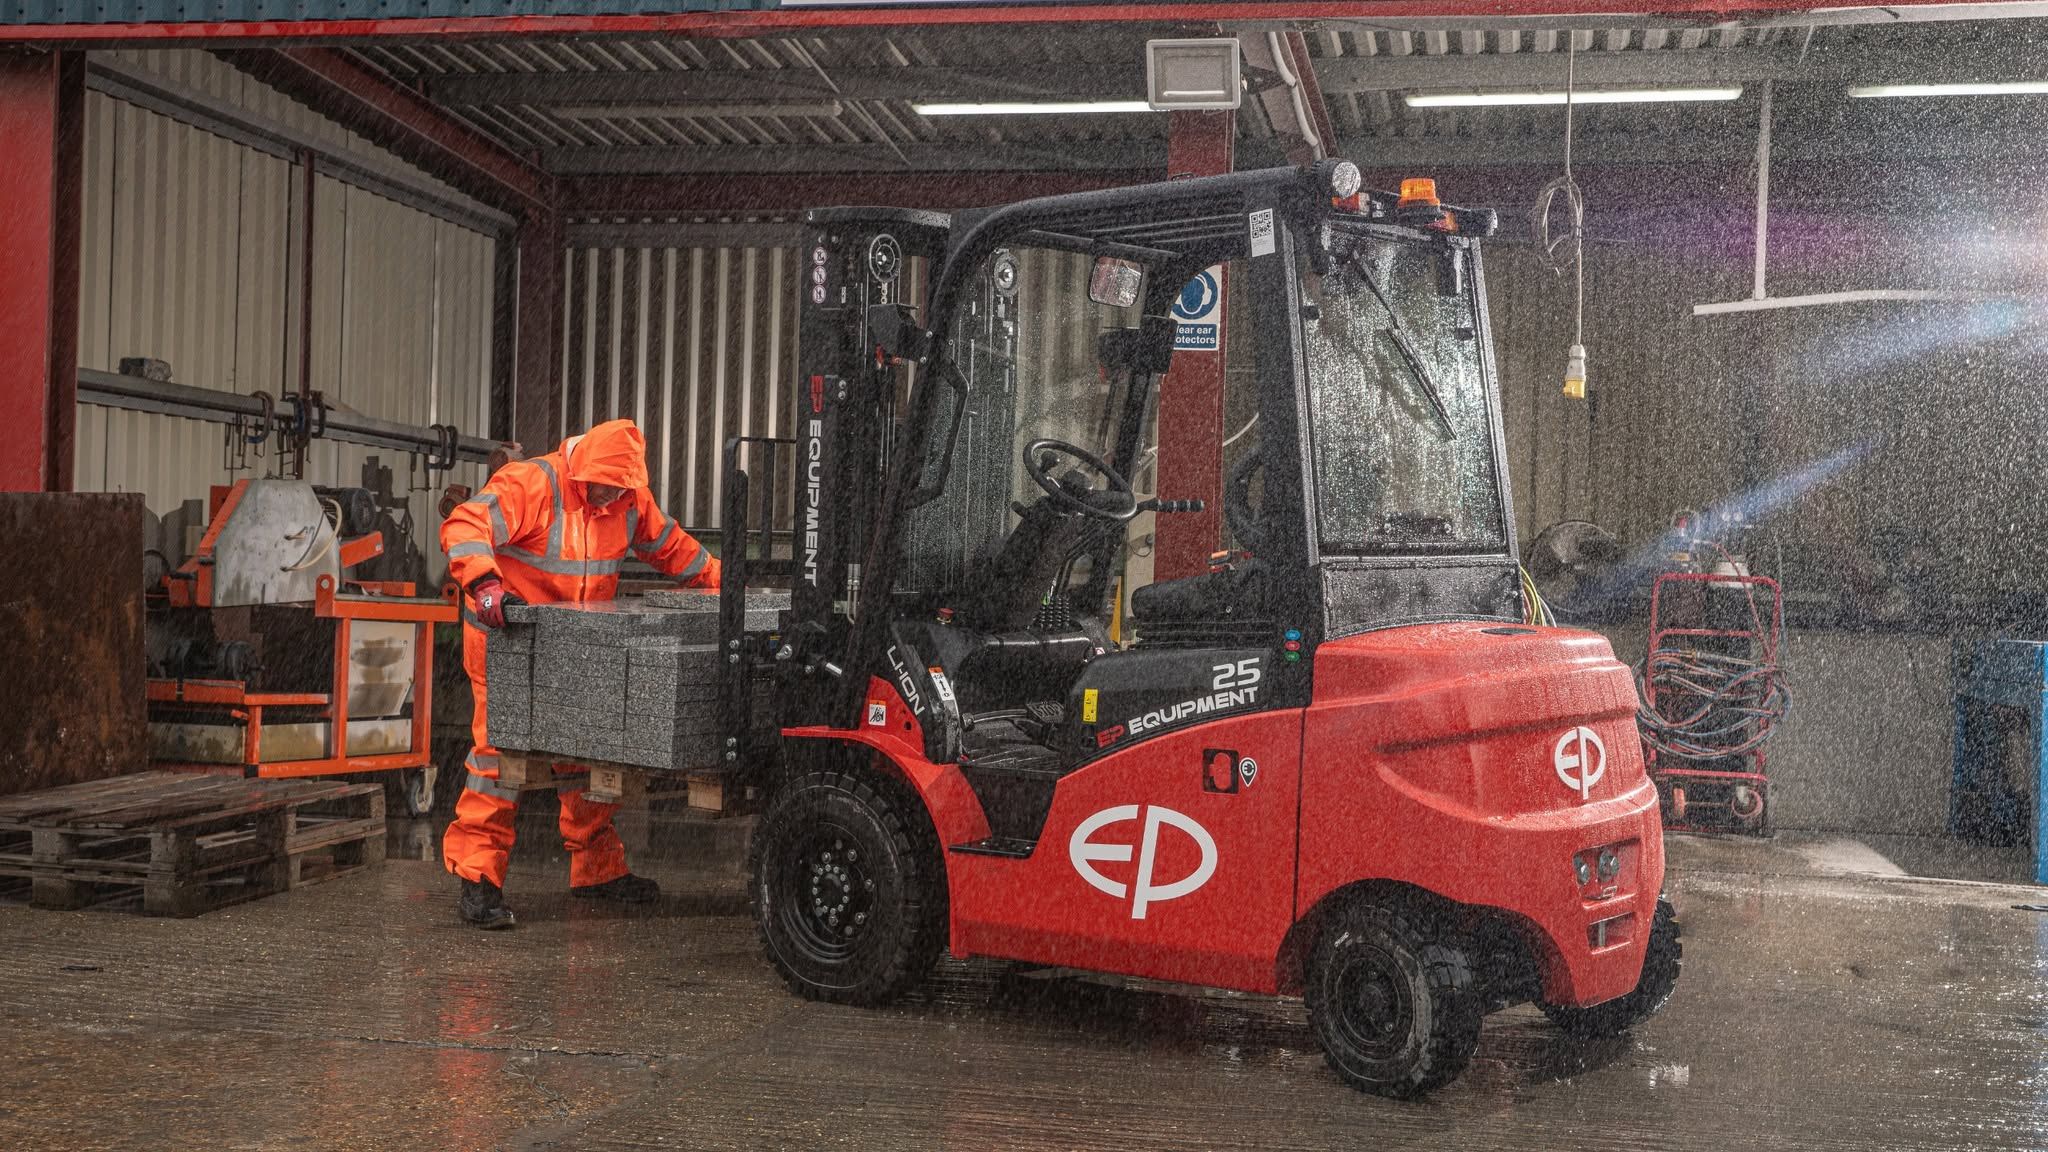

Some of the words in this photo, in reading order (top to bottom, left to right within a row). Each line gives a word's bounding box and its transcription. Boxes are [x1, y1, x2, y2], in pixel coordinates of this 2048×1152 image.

[1175, 335, 1216, 344] otectors
[1176, 325, 1195, 334] ear
[1196, 326, 1213, 335] ear
[810, 375, 824, 413] EP
[804, 420, 822, 587] EQUIPMENT
[887, 645, 925, 715] LI-ION
[1213, 657, 1261, 690] 25
[1096, 724, 1125, 746] EP
[1128, 688, 1258, 735] EQUIPMENT
[1554, 726, 1606, 800] EP
[1069, 804, 1218, 919] EP
